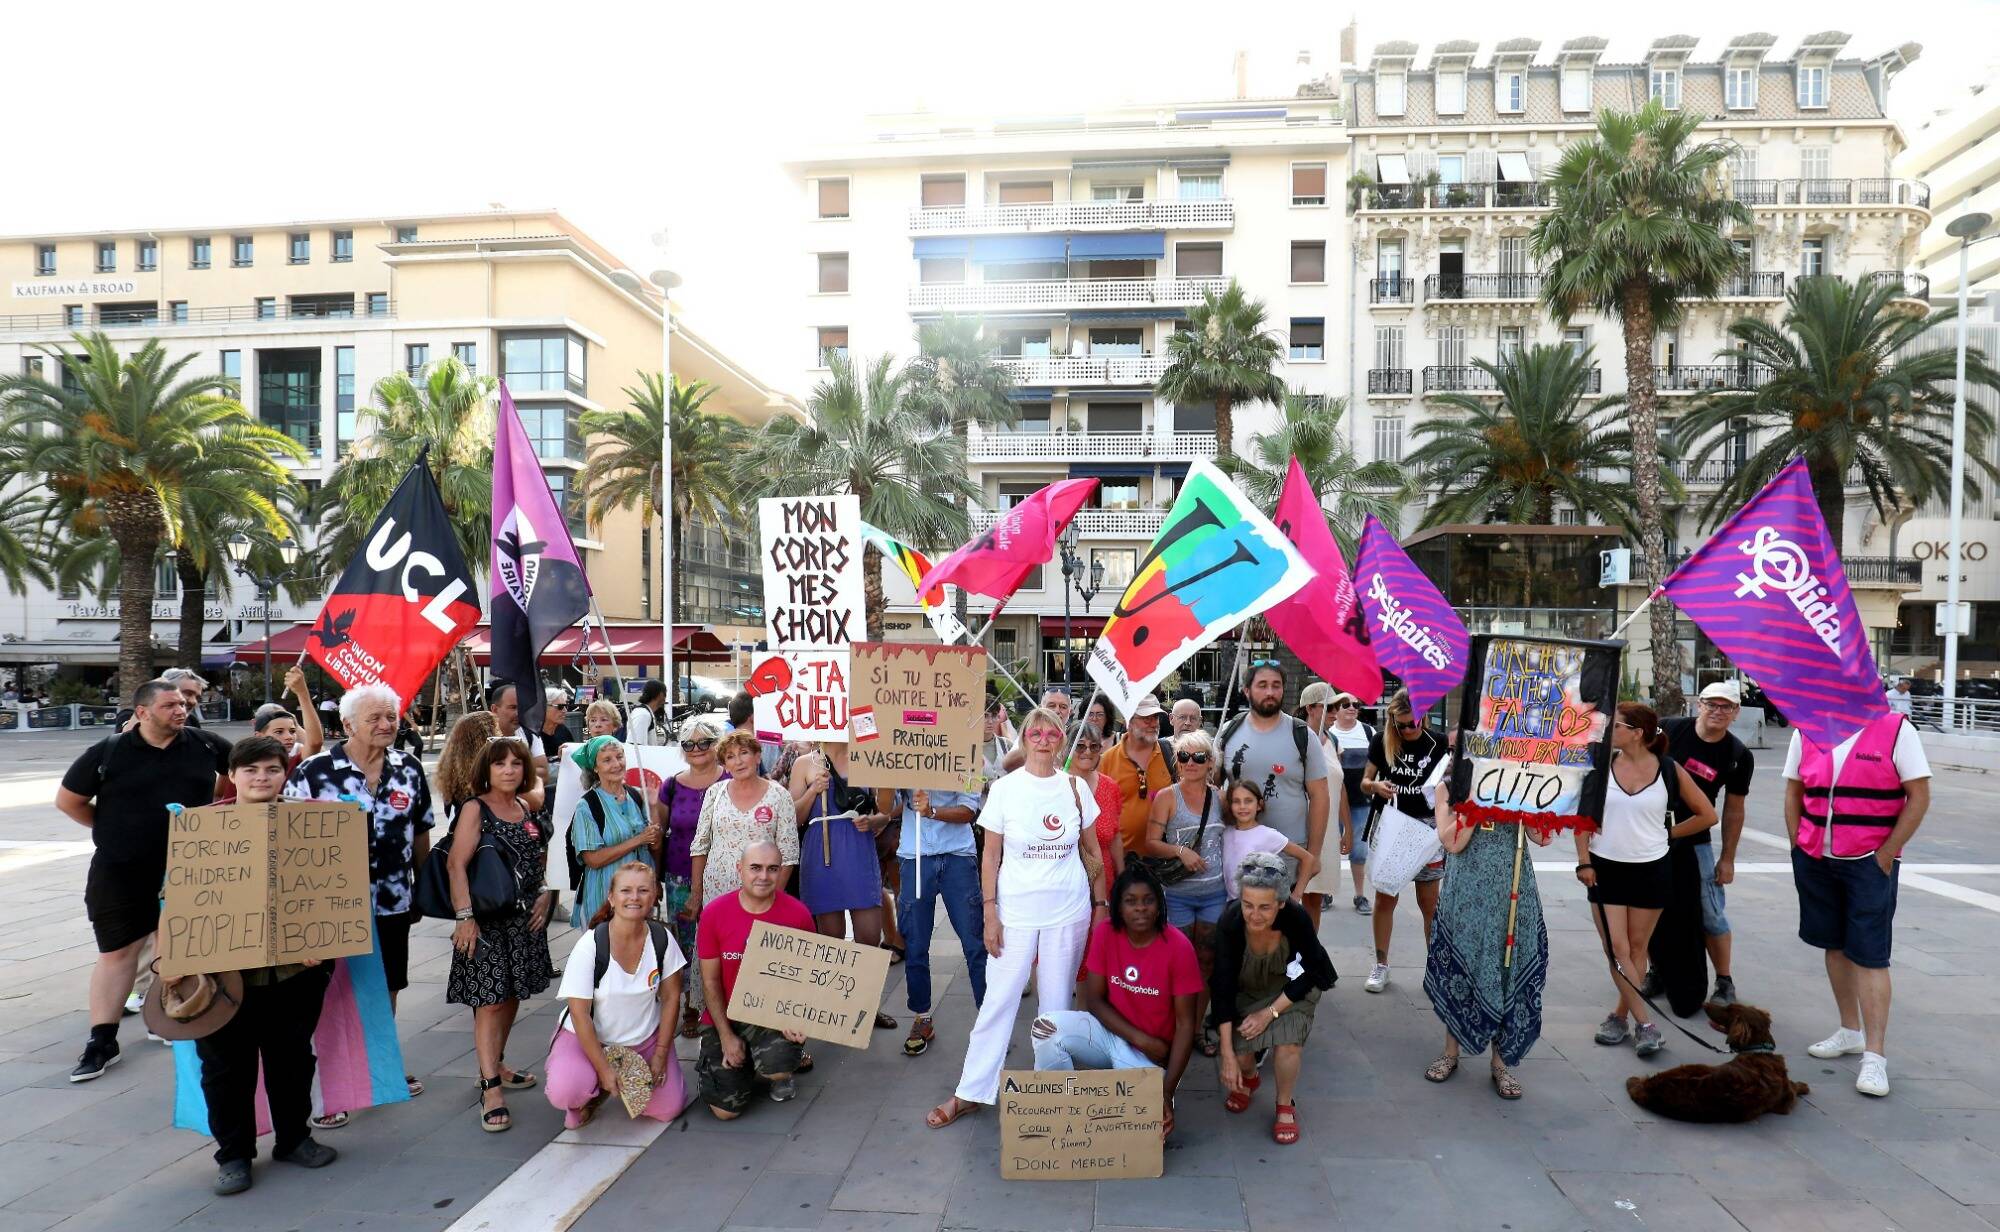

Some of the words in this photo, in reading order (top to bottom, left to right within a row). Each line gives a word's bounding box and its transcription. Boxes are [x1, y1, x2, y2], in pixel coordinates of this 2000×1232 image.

[16, 285, 75, 297] KAUFMAN
[93, 282, 133, 294] BROAD
[781, 500, 837, 535] MON
[770, 535, 850, 574] CORPS
[1603, 552, 1611, 574] P
[366, 517, 468, 634] UCL
[787, 573, 839, 606] MES
[239, 605, 282, 618] Affliem
[771, 606, 852, 645] CHOIX
[339, 648, 391, 688] COMMUN
[352, 640, 386, 674] UNION
[325, 653, 364, 690] LIBERTA
[808, 660, 846, 693] TA
[903, 671, 920, 686] TU
[934, 673, 952, 688] ES
[875, 688, 927, 707] CONTRE
[1488, 672, 1567, 706] CATHOS
[775, 691, 848, 730] GUEU
[1488, 701, 1592, 738] FACHOS
[1402, 754, 1415, 763] JE
[1492, 738, 1531, 759] NOUS
[1390, 766, 1423, 777] PARLE
[1477, 767, 1562, 809] CLITO
[174, 812, 201, 832] NO
[288, 810, 351, 840] KEEP
[171, 839, 253, 860] FORCING
[282, 845, 342, 868] YOUR
[280, 873, 348, 894] LAWS
[194, 890, 223, 907] ON
[284, 898, 316, 915] OFF
[325, 896, 363, 911] THEIR
[281, 920, 369, 954] BODIES
[722, 952, 743, 960] SOSh
[760, 931, 861, 968] AVORTEMENT
[1065, 1076, 1110, 1097] FEMMES
[1068, 1106, 1081, 1116] DE
[1134, 1105, 1148, 1115] DE
[1013, 1156, 1061, 1171] DONC
[1071, 1157, 1116, 1169] MERDE
